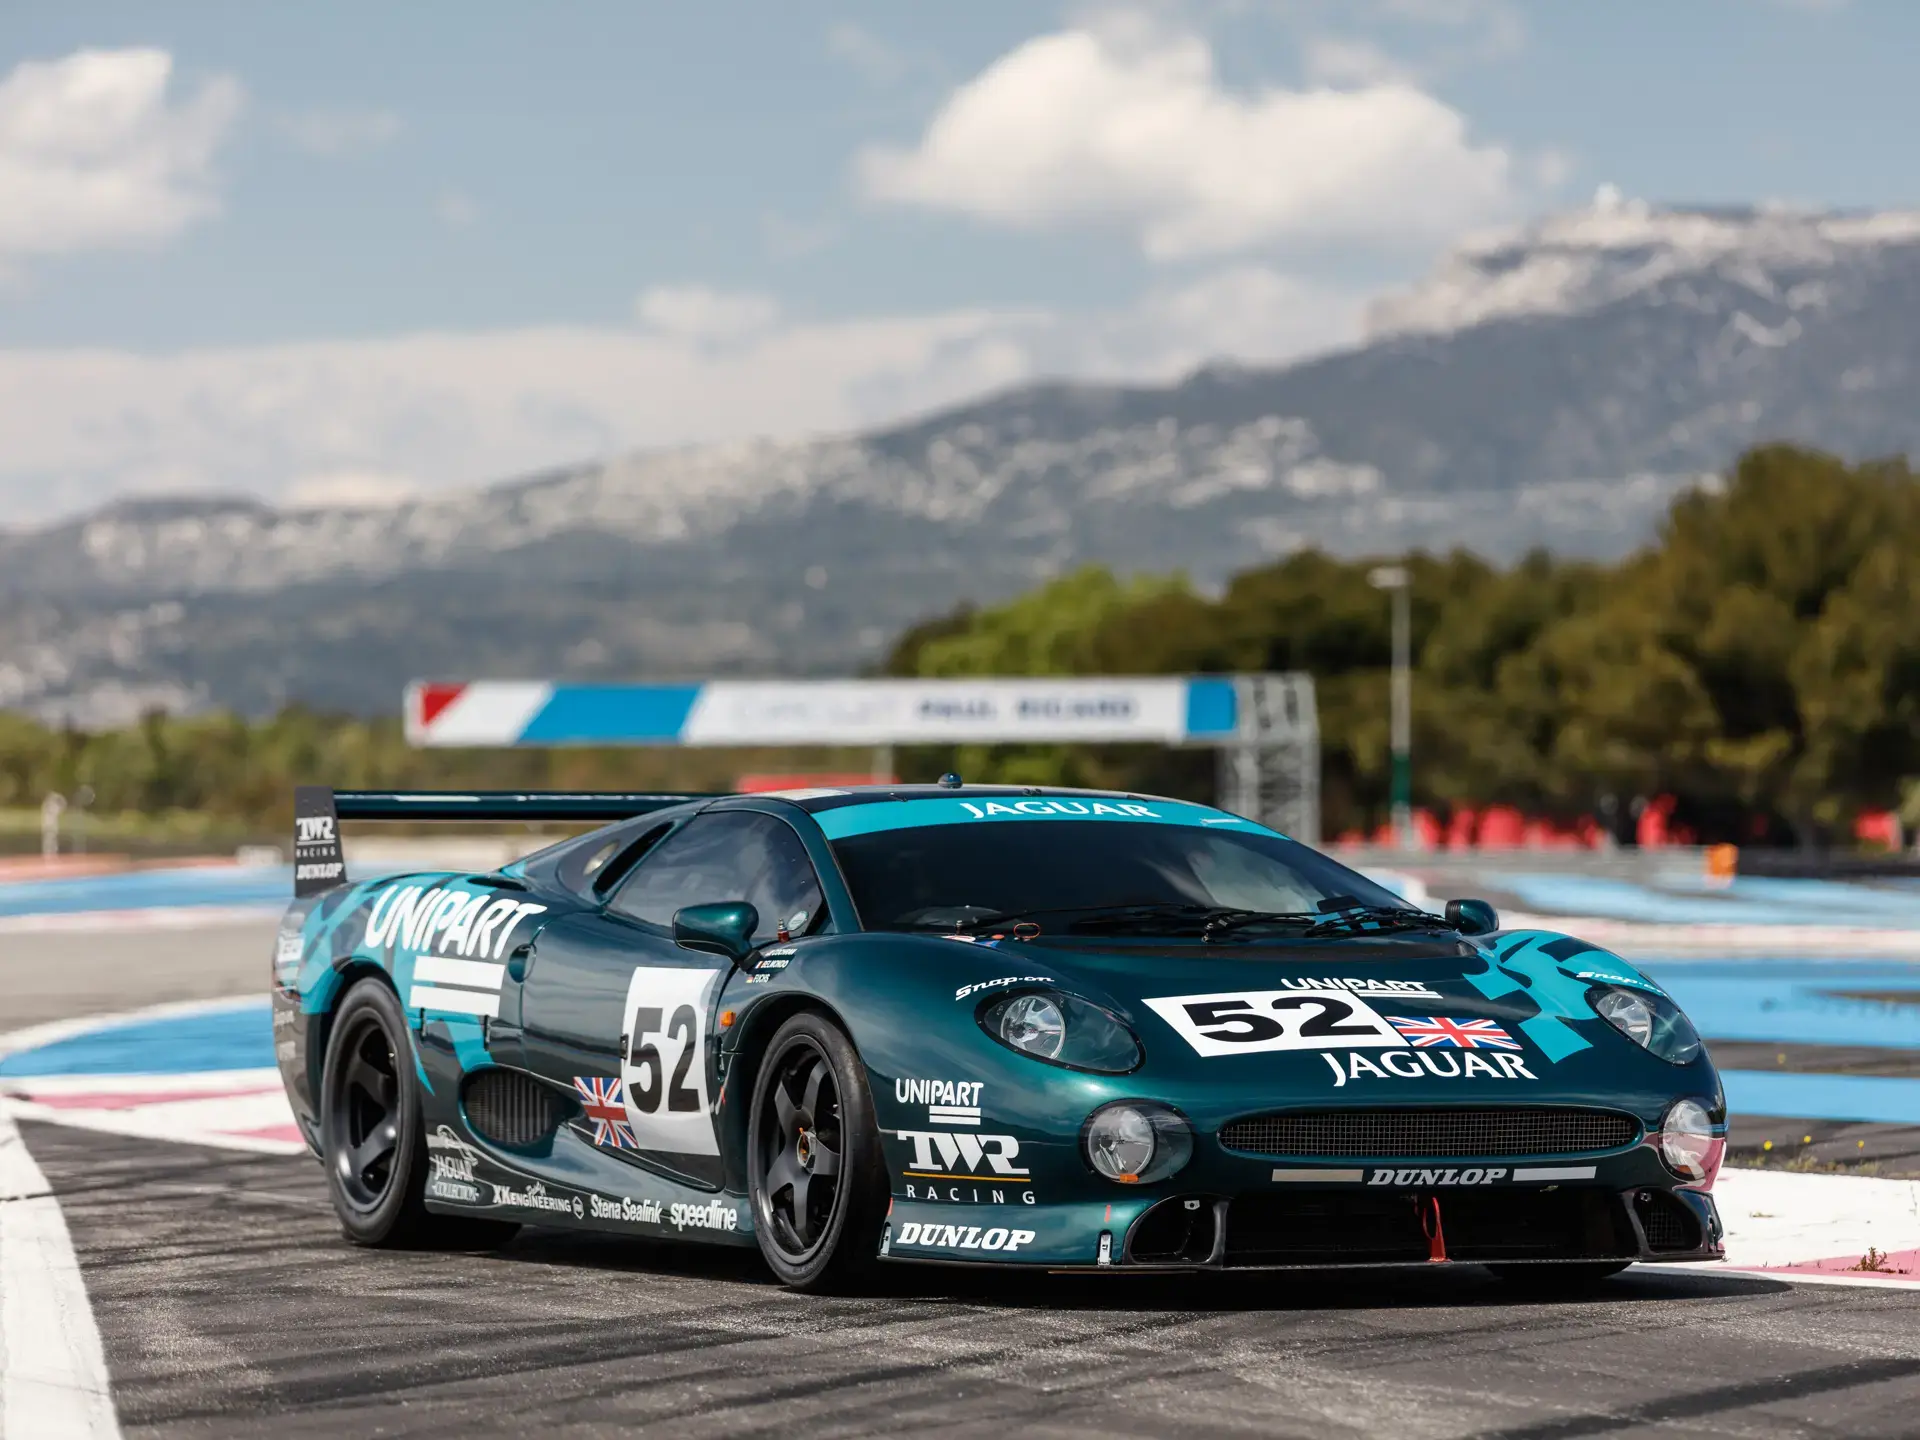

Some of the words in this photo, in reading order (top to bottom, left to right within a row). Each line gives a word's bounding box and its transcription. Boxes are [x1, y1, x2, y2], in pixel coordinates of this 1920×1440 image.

[960, 801, 1162, 819] JAGUAR
[296, 816, 336, 841] TWR
[296, 847, 336, 858] RACING
[297, 862, 343, 880] DUNLOP
[364, 884, 548, 960] UNIPART
[753, 973, 771, 983] FUCHS
[955, 976, 1055, 1001] Snap-on
[1281, 977, 1429, 993] UNIPART
[1182, 996, 1383, 1042] 52
[629, 1004, 701, 1114] 52
[1320, 1051, 1539, 1087] JAGUAR
[896, 1078, 984, 1106] UNIPART
[897, 1130, 1030, 1175] TWR
[1367, 1167, 1507, 1186] DUNLOP
[906, 1184, 1036, 1205] RACING
[590, 1193, 621, 1219] Stena
[622, 1196, 663, 1224] Sealink
[670, 1199, 738, 1231] speedline
[896, 1222, 1036, 1251] DUNLOP
